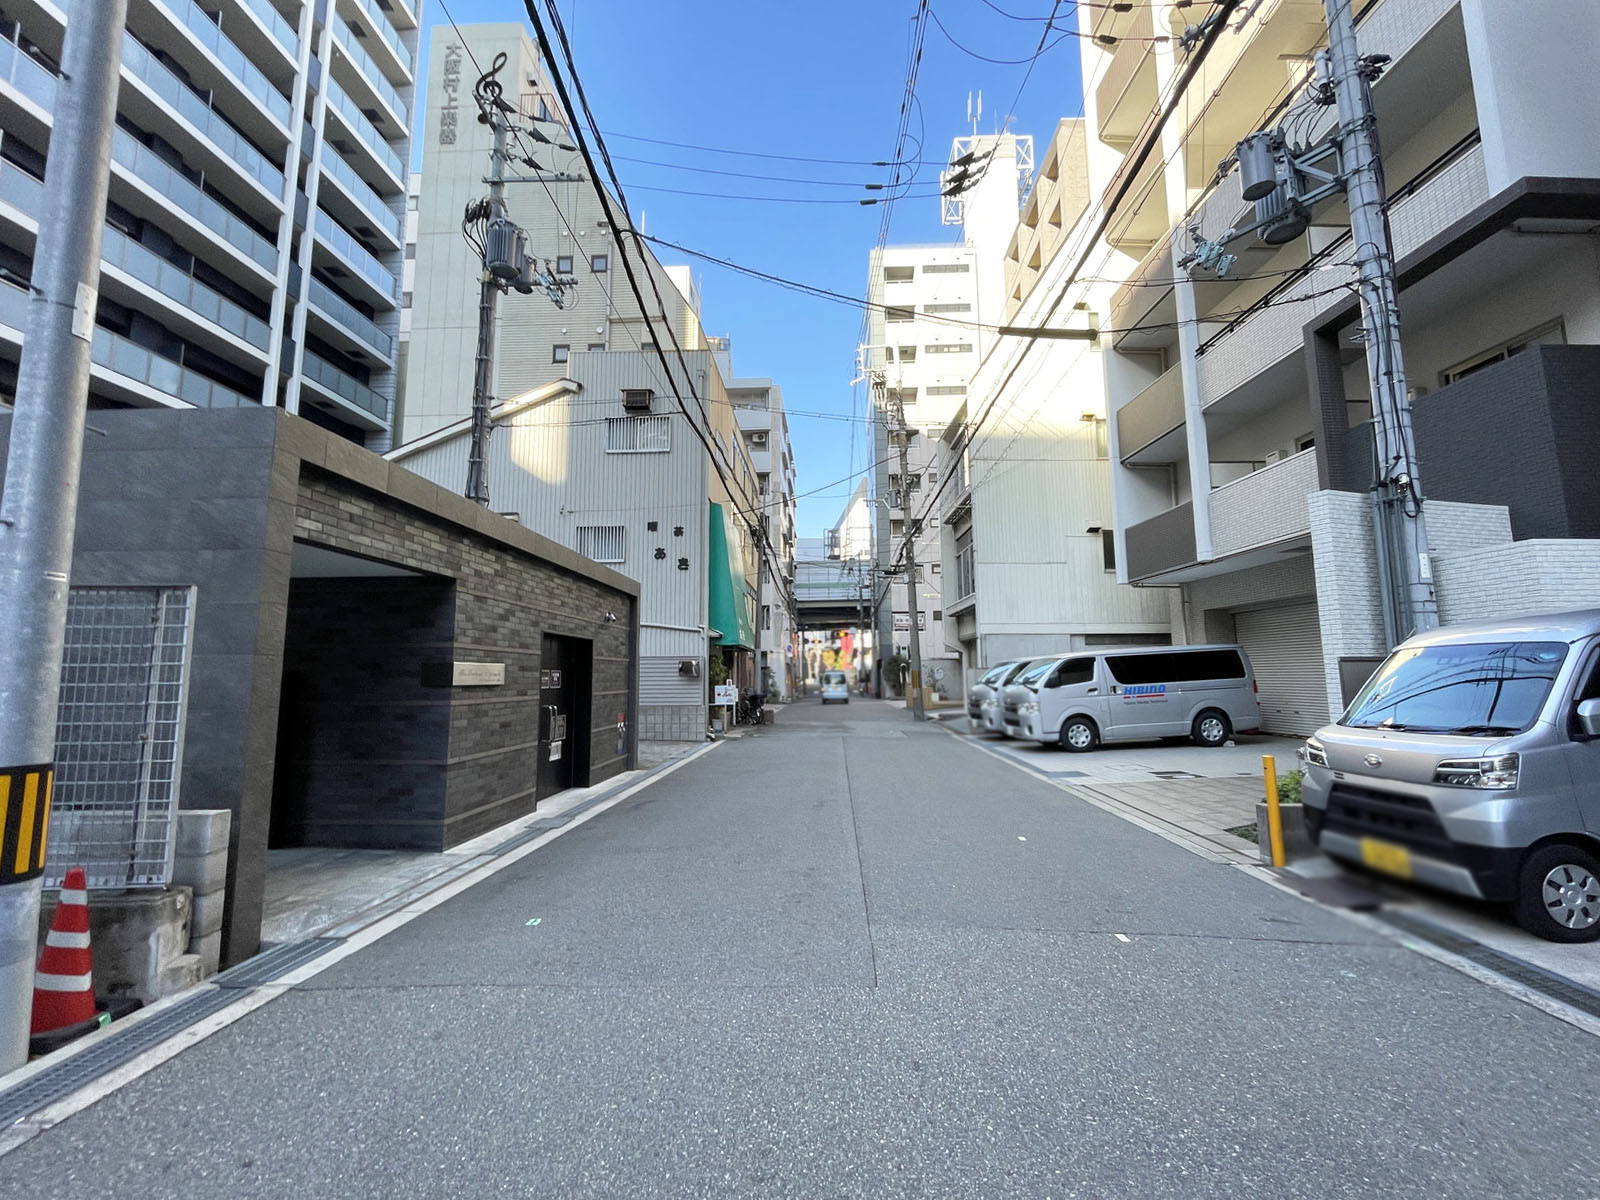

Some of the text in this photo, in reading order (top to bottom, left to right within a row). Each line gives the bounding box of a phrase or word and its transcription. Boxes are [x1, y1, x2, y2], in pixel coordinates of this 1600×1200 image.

[439, 42, 462, 145] 大阪村上楽器
[1123, 684, 1166, 695] HIBINO
